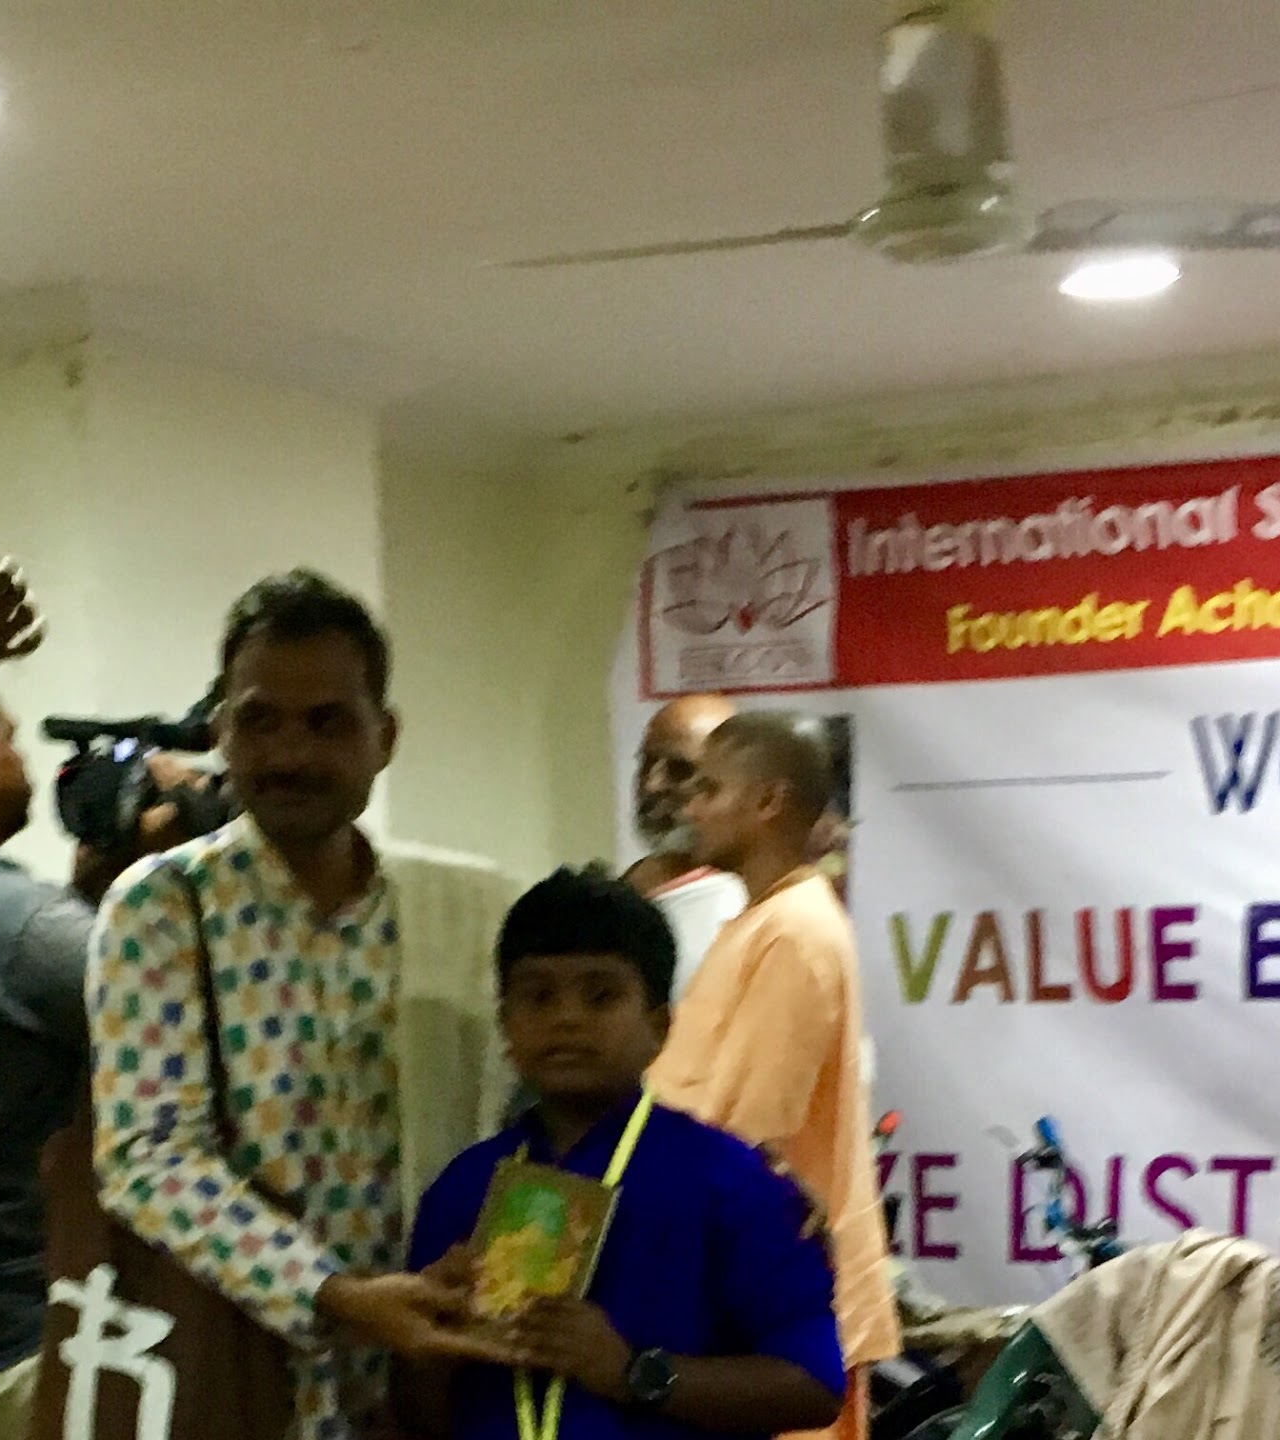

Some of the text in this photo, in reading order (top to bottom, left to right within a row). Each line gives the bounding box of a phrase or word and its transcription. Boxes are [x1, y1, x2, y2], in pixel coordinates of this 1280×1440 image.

[847, 486, 1241, 578] International
[945, 590, 1150, 655] Founder
[887, 901, 1201, 1006] VALUE
